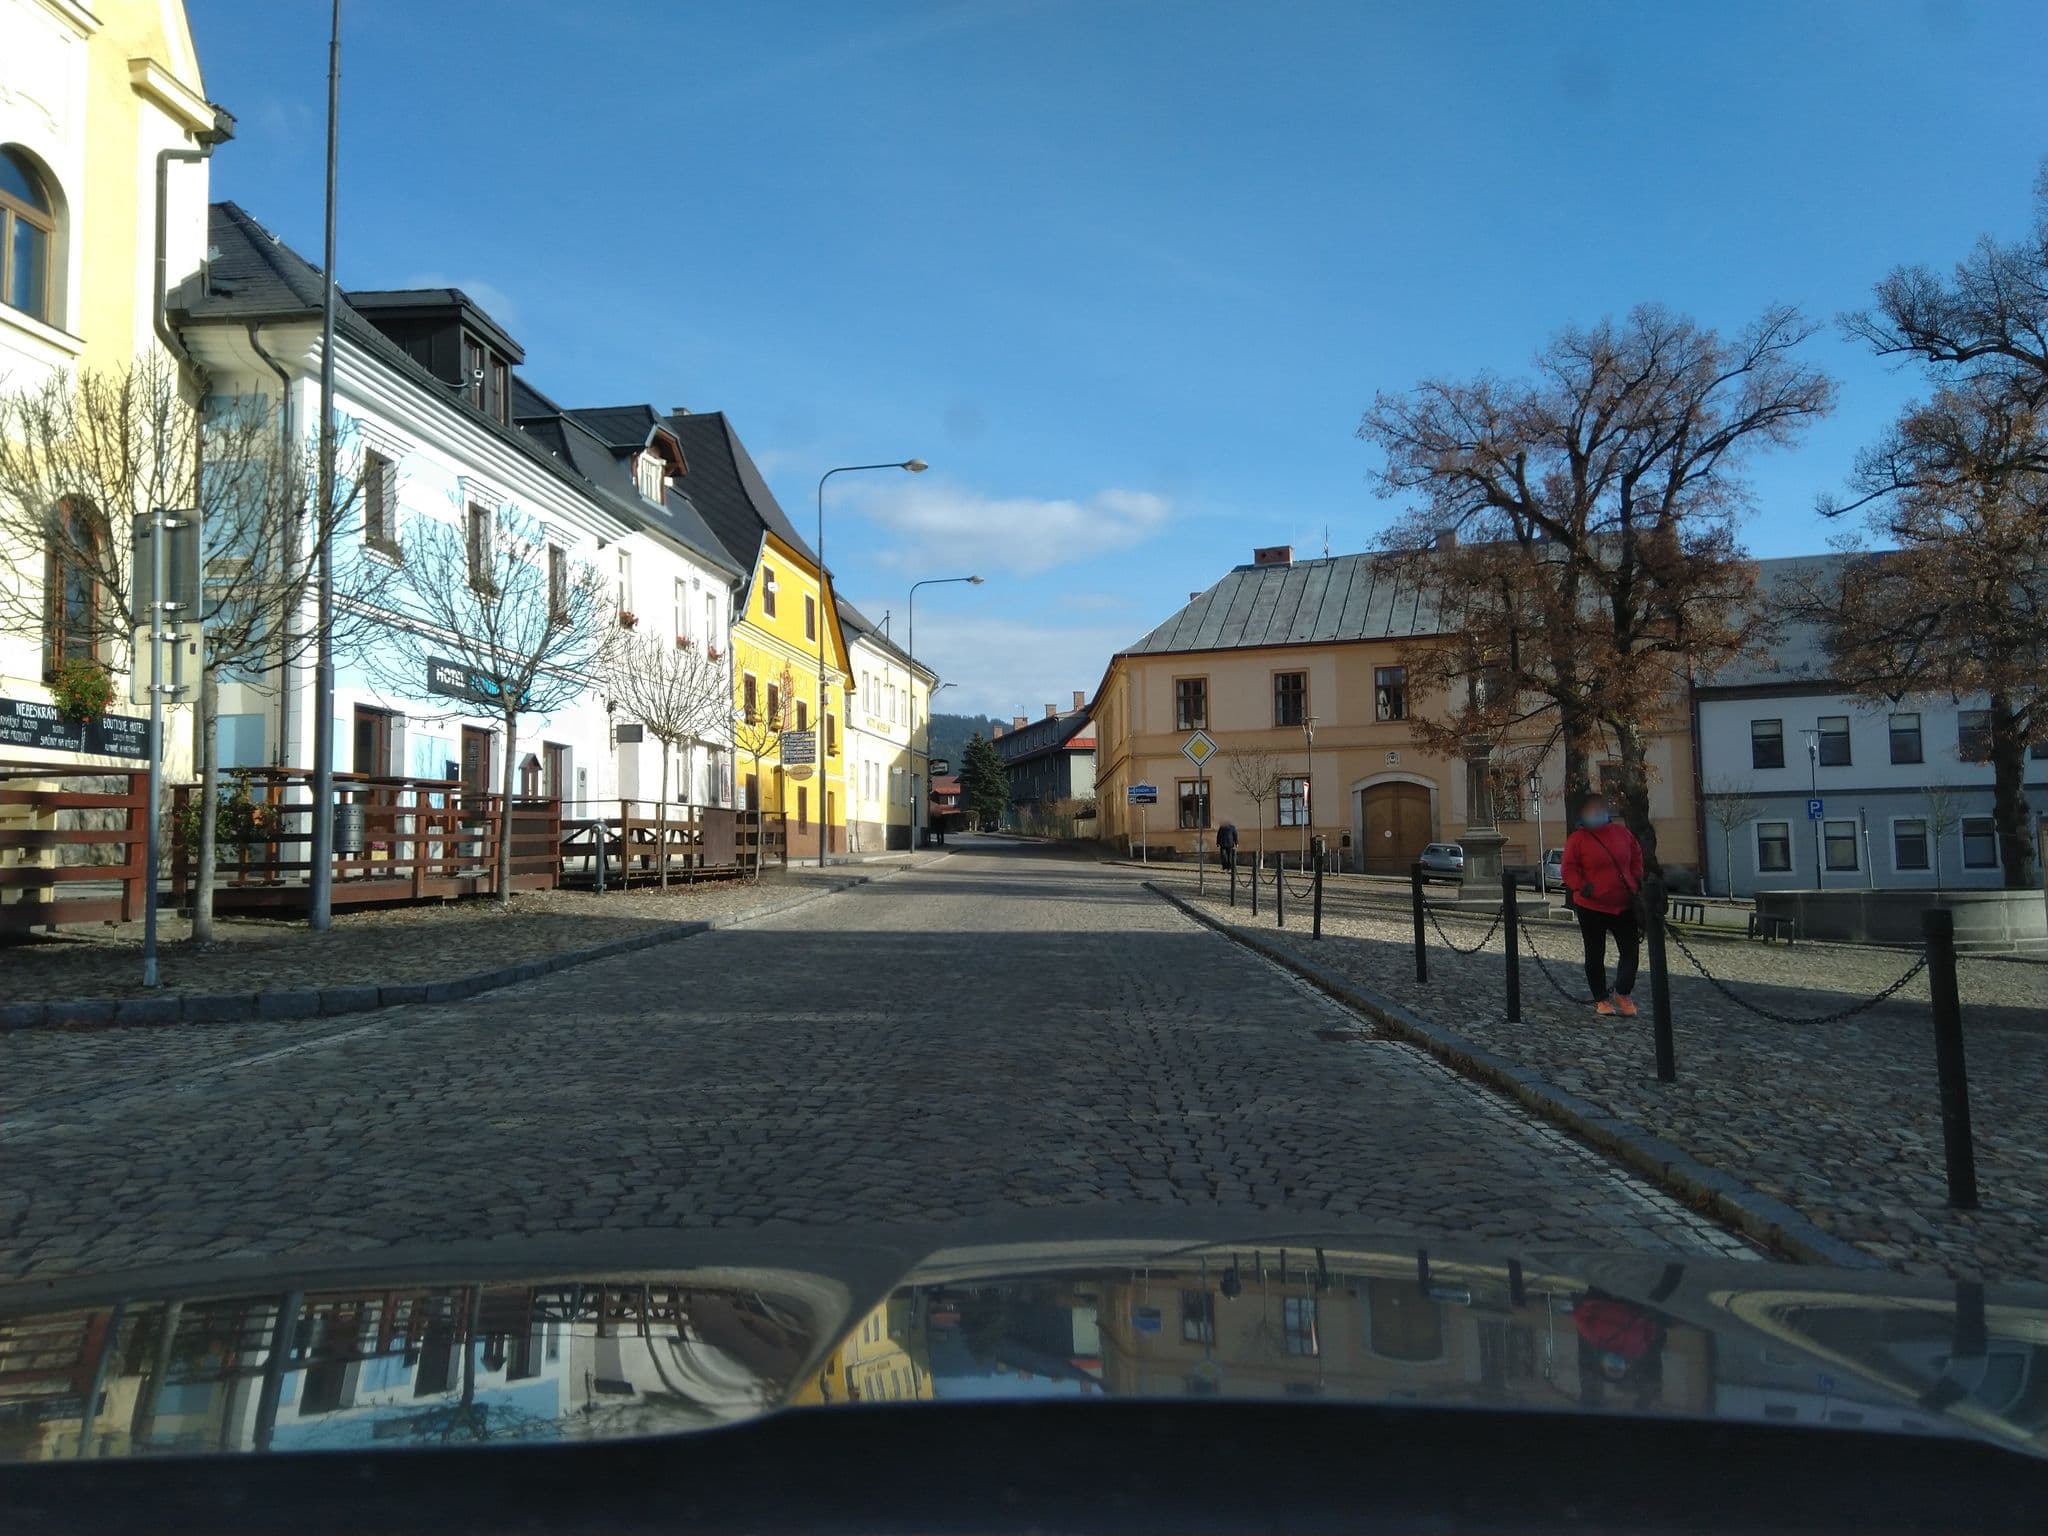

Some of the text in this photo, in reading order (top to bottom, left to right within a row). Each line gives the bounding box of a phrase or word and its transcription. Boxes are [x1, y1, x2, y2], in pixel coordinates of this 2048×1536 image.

[436, 667, 466, 688] HOTEL
[102, 717, 146, 734] BOUTIQUE HOTEL
[1810, 801, 1820, 814] P
